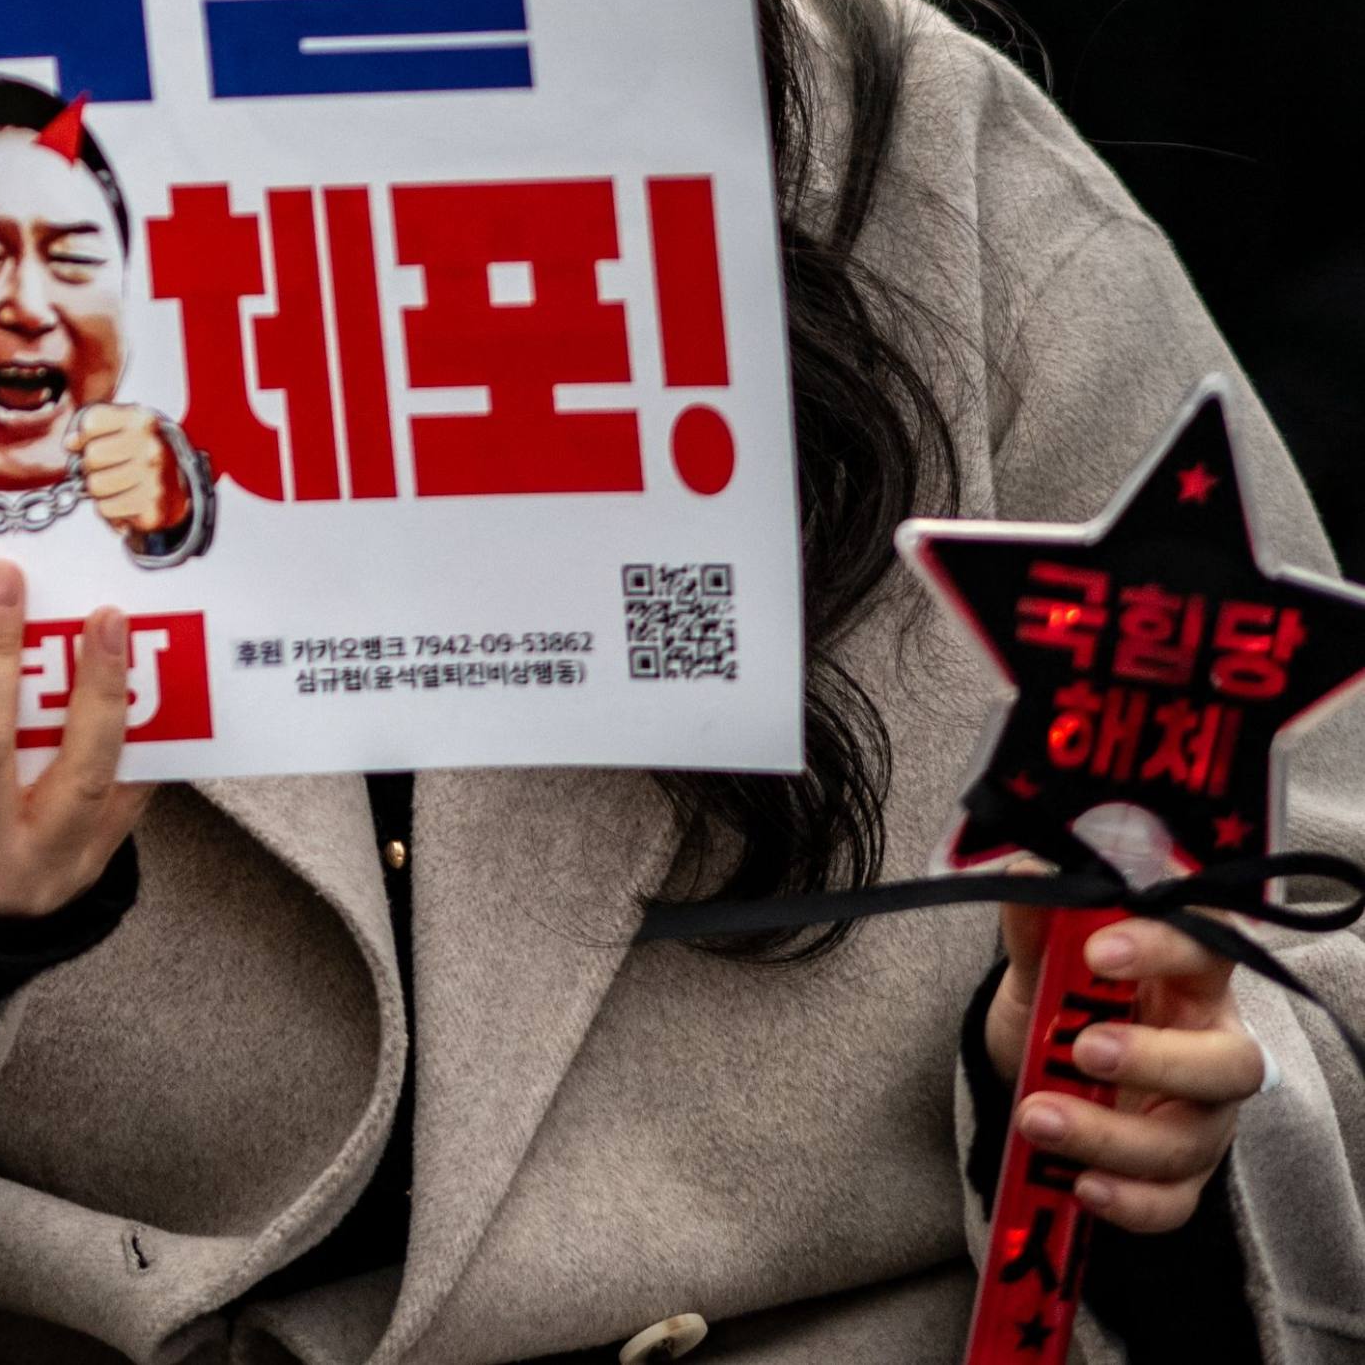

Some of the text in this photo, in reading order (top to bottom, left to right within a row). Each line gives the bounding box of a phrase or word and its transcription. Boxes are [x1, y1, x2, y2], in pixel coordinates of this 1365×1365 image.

[145, 175, 736, 502] 체포!
[236, 632, 595, 666] 후원 카카오뱅크 7942-09-53862
[1014, 561, 1308, 700] 국힘당
[1046, 680, 1243, 797] 해체
